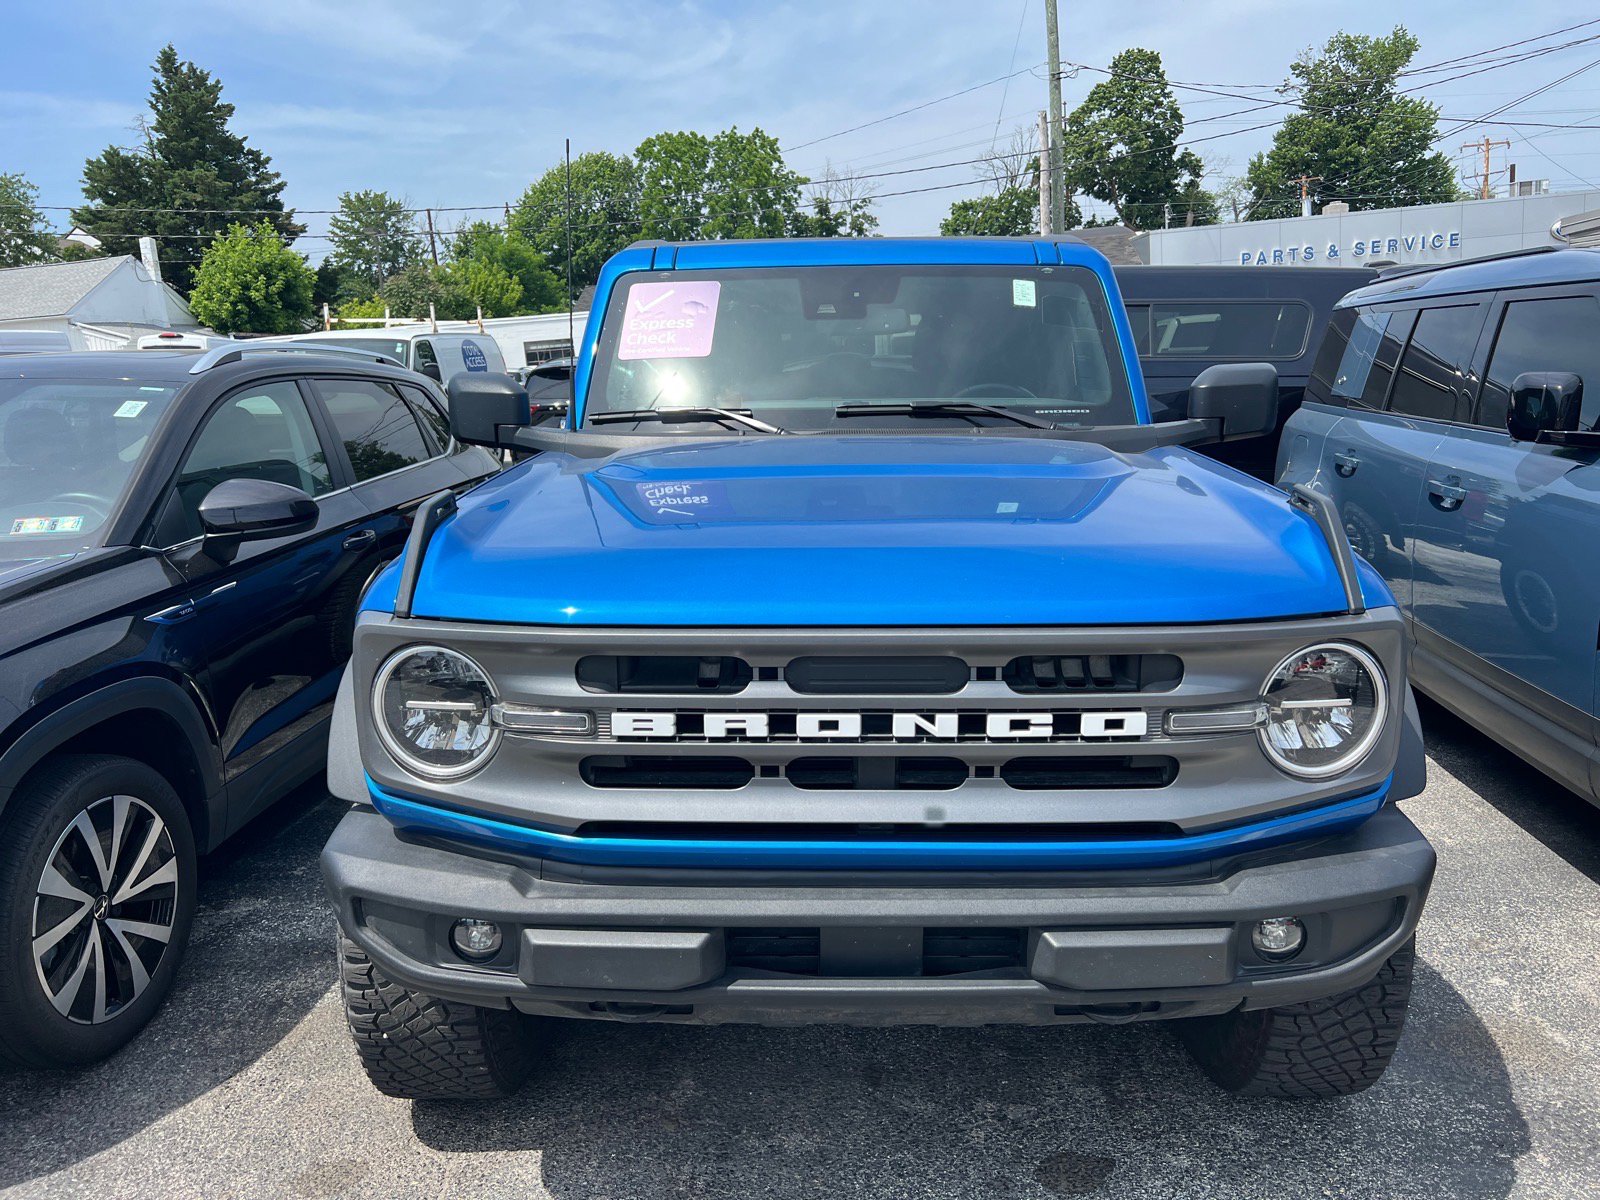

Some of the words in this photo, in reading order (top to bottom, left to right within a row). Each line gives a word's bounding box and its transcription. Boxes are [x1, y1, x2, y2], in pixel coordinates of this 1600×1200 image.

[1240, 246, 1314, 265] PARTS
[1328, 243, 1339, 258] &
[1353, 232, 1460, 256] SERVICE
[630, 319, 695, 331] Express
[627, 332, 676, 345] Check
[462, 345, 481, 356] TOTAL
[465, 356, 487, 368] ACCESS
[611, 711, 1148, 738] BRONCO
